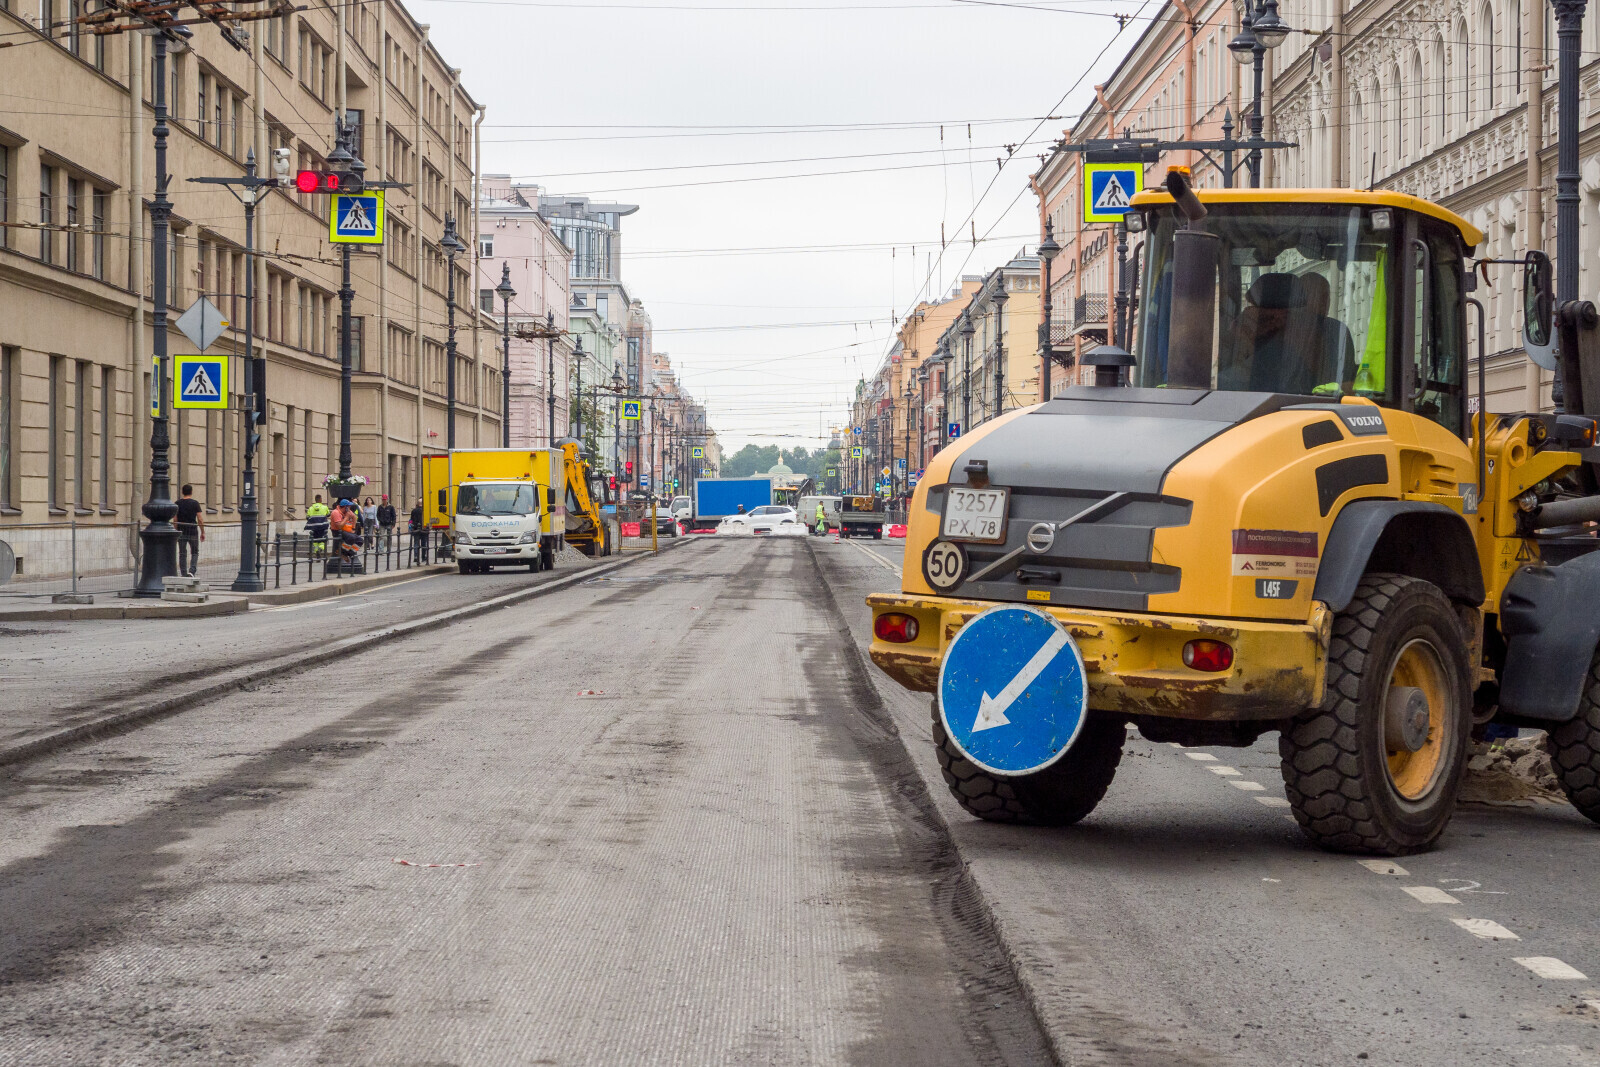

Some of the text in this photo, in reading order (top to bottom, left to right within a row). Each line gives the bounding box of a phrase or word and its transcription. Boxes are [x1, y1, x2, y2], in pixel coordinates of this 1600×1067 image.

[1347, 416, 1382, 427] VOLVO
[954, 492, 997, 513] 3257
[471, 520, 520, 528] ВОДОКАНАЛ
[949, 519, 996, 535] РХ 78
[930, 550, 959, 578] 50
[1264, 580, 1281, 597] L45F
